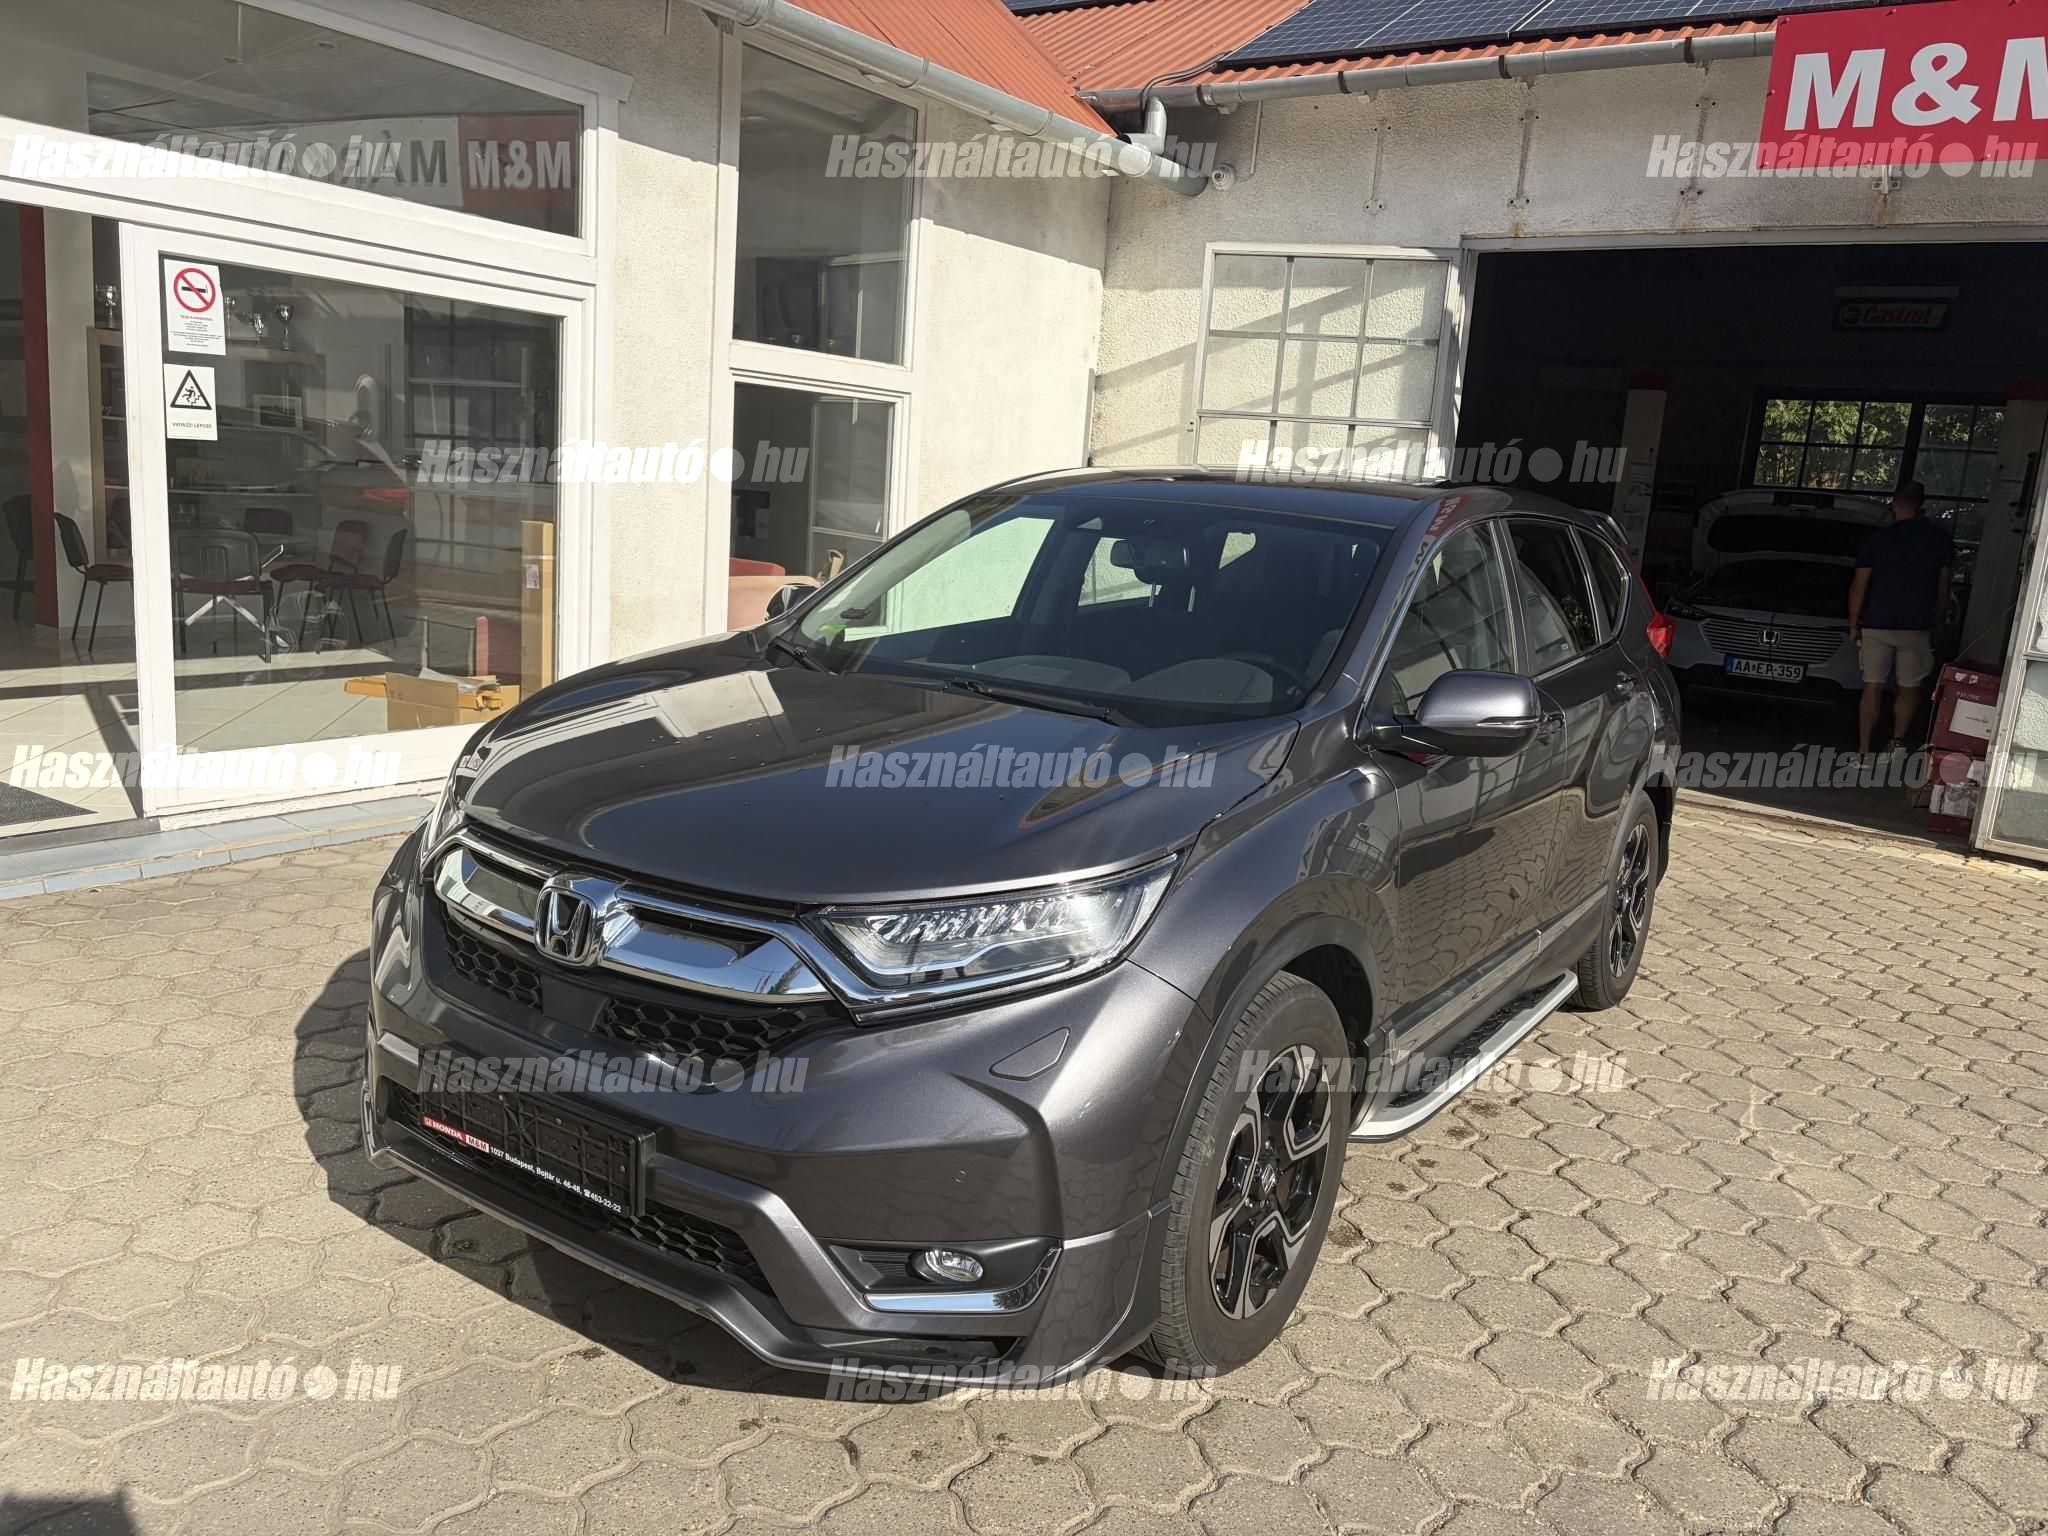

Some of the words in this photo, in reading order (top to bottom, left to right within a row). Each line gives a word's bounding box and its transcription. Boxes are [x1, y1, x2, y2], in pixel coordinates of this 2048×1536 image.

[1862, 304, 1934, 325] Castrol
[432, 1121, 463, 1140] HONDA
[467, 1135, 488, 1151] M&M
[490, 1146, 504, 1158] 1037
